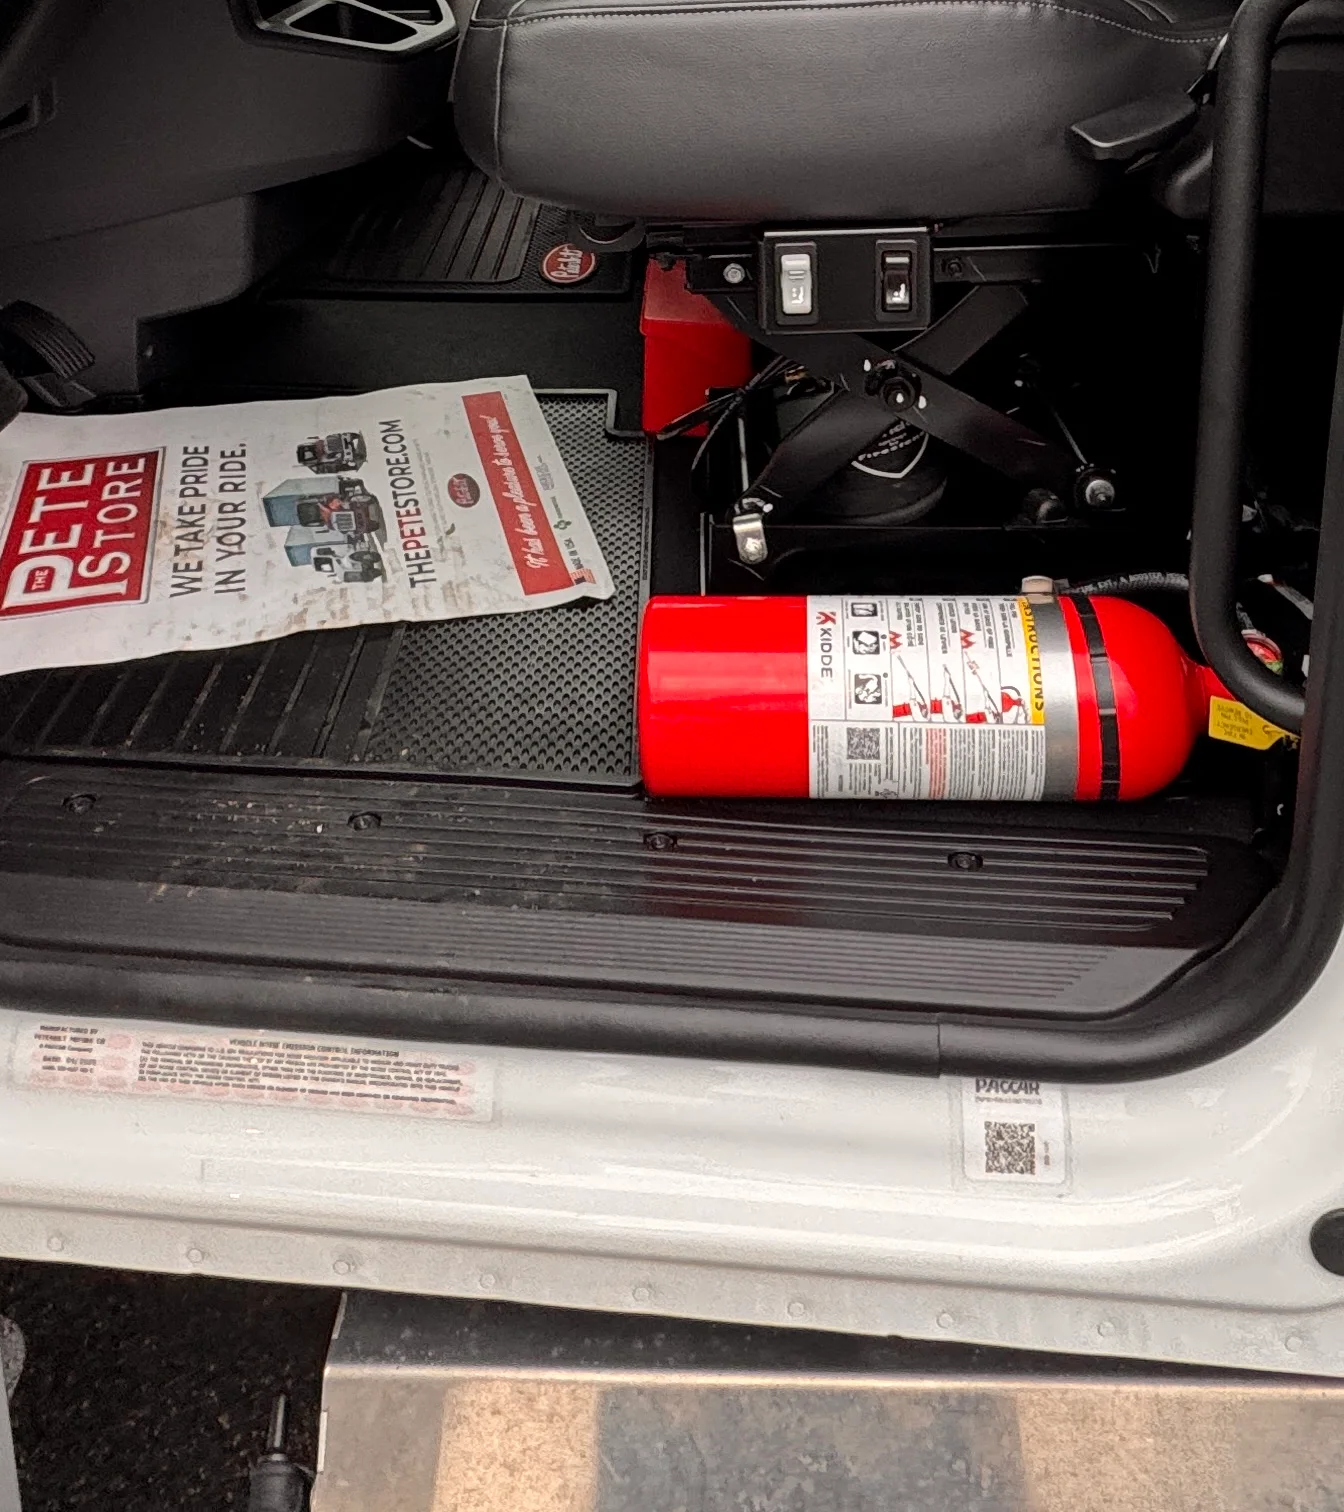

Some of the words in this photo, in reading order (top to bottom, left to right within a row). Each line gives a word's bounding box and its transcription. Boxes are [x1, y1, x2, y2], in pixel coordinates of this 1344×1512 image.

[491, 433, 509, 457] serve
[491, 457, 513, 467] to
[179, 446, 209, 498] PRIDE
[218, 443, 247, 493] RIDE.
[502, 467, 537, 506] pleasure
[77, 456, 146, 578] STORE
[378, 419, 437, 588] THEPETESTORE.COM
[0, 463, 129, 611] PETE
[172, 503, 206, 557] TAKE
[215, 500, 247, 562] YOUR
[516, 513, 538, 535] been
[520, 538, 544, 554] has
[525, 555, 550, 569] It
[30, 569, 49, 591] THE
[169, 560, 204, 598] WE
[214, 569, 246, 594] IN
[819, 628, 833, 678] KIDDE
[975, 1077, 1041, 1096] PACCAR
